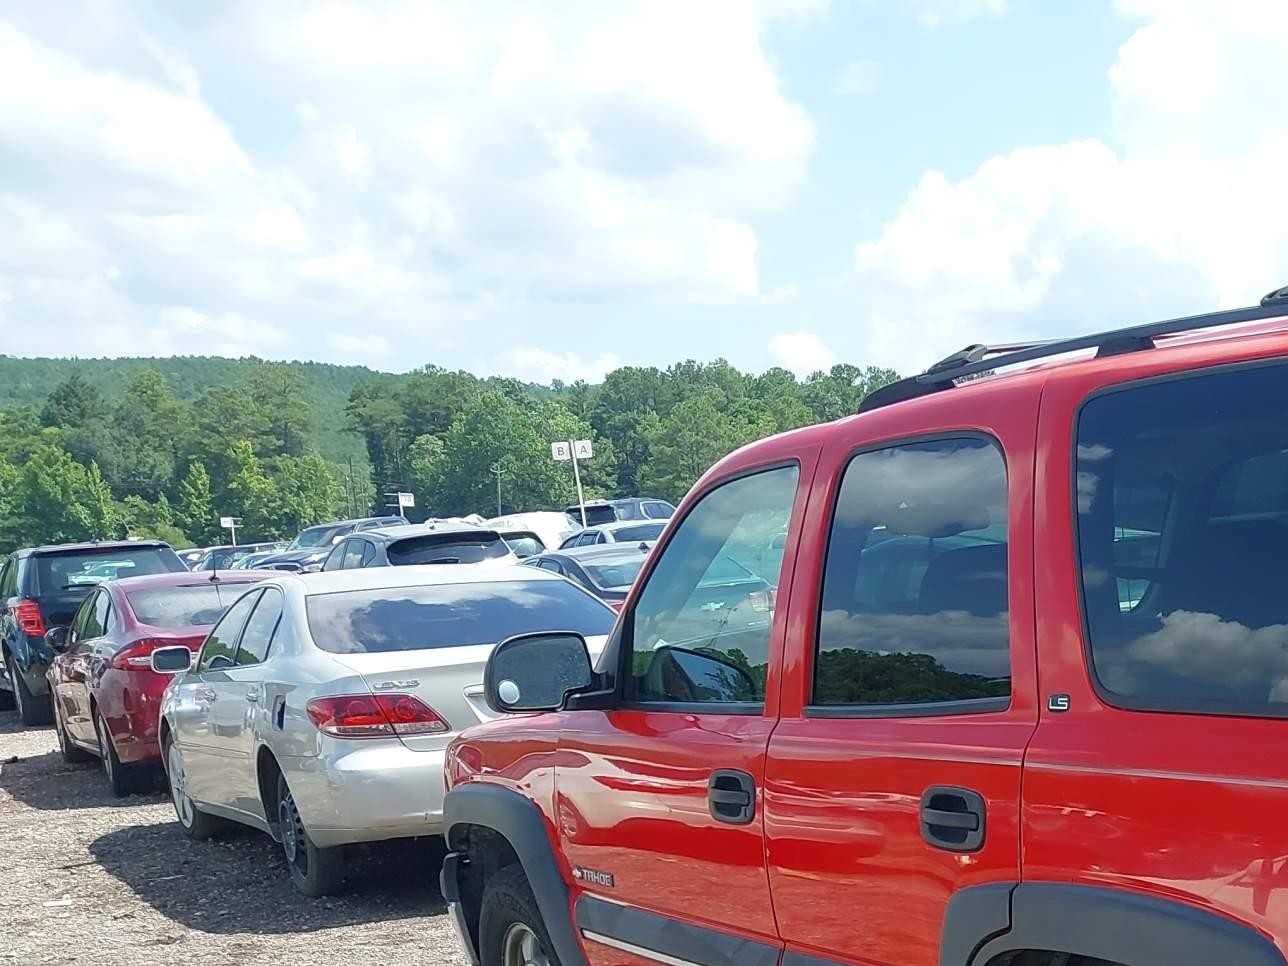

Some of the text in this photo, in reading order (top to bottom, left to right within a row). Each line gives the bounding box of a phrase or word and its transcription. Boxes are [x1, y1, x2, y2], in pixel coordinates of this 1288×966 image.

[556, 446, 566, 457] B
[580, 444, 588, 455] A
[1048, 696, 1069, 710] LS
[582, 869, 613, 887] TAHOE
